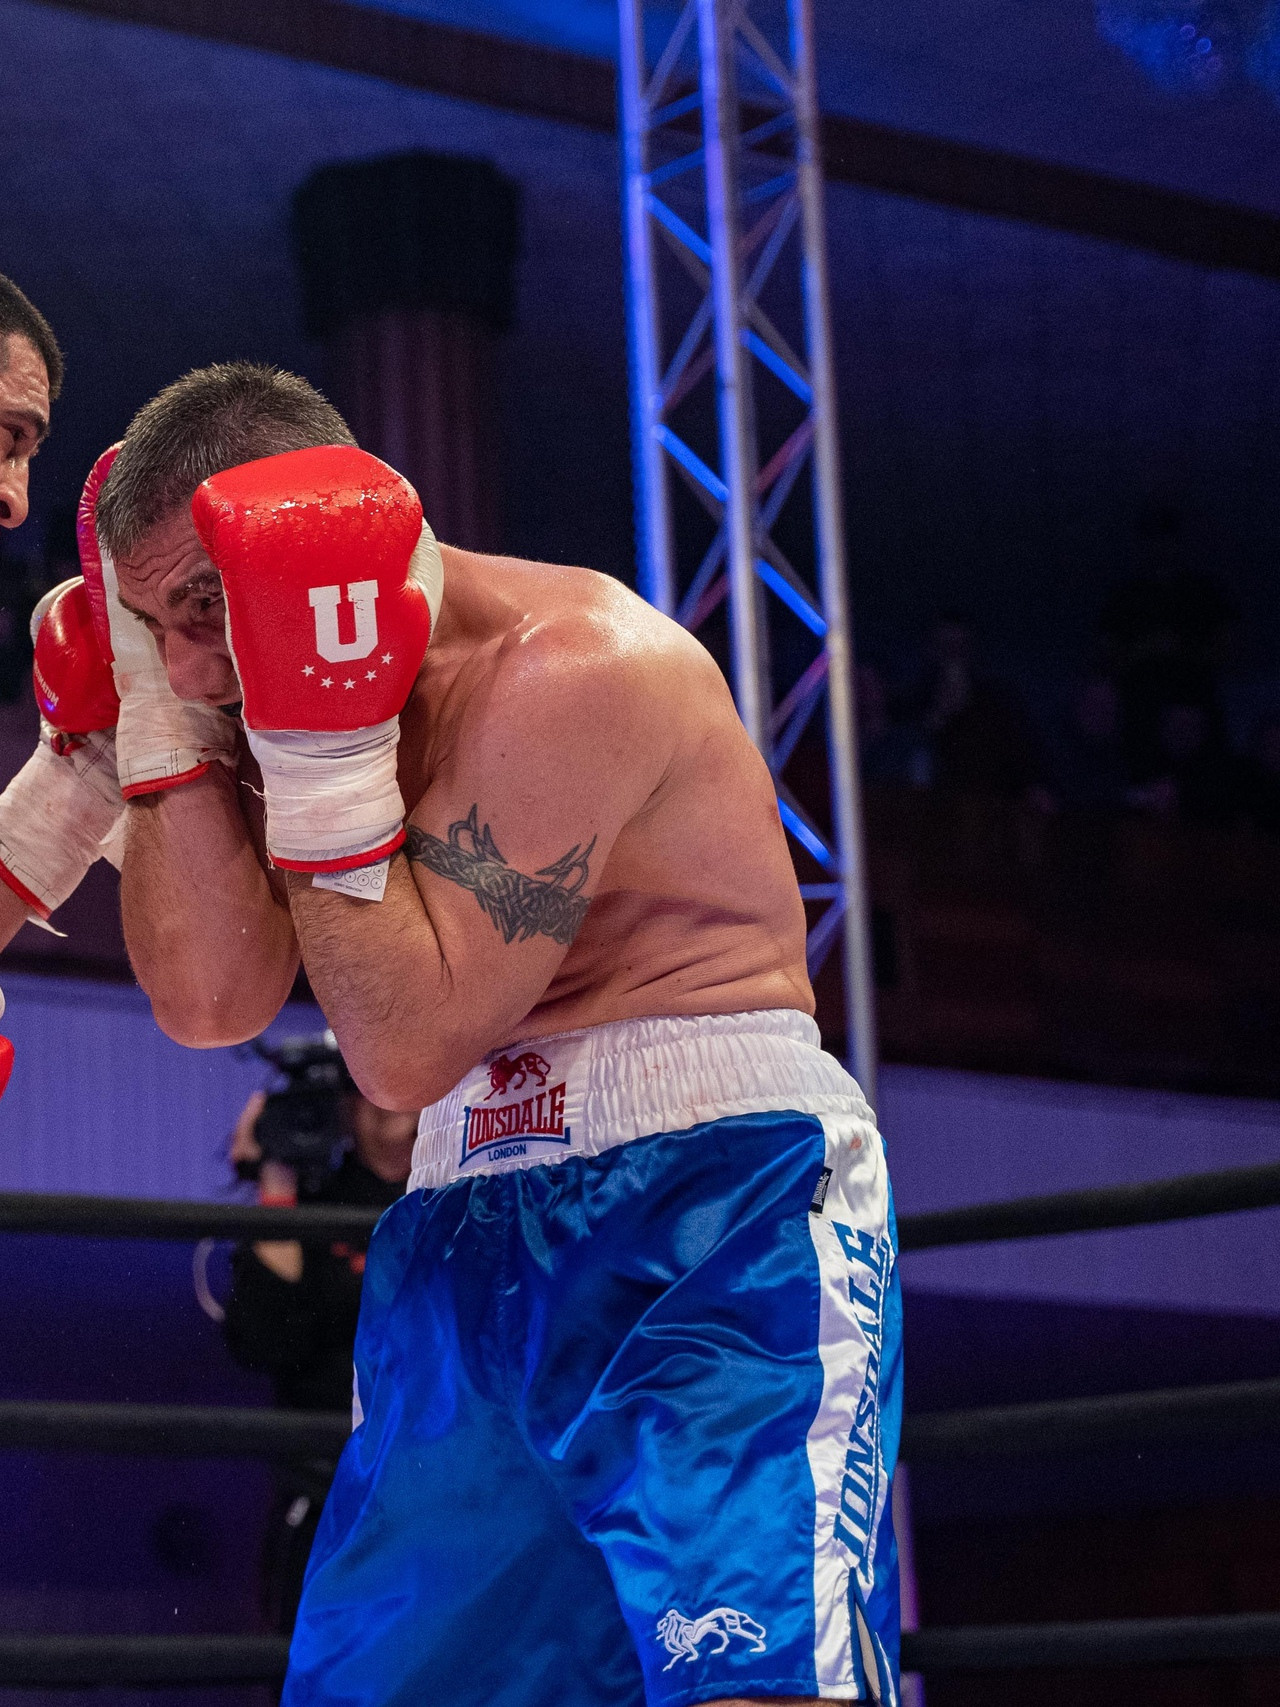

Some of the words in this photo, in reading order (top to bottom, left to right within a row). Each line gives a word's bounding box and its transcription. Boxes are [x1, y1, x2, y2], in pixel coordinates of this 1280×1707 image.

[308, 579, 380, 664] U
[459, 1082, 570, 1168] LONSDALE
[488, 1144, 527, 1162] LONDON
